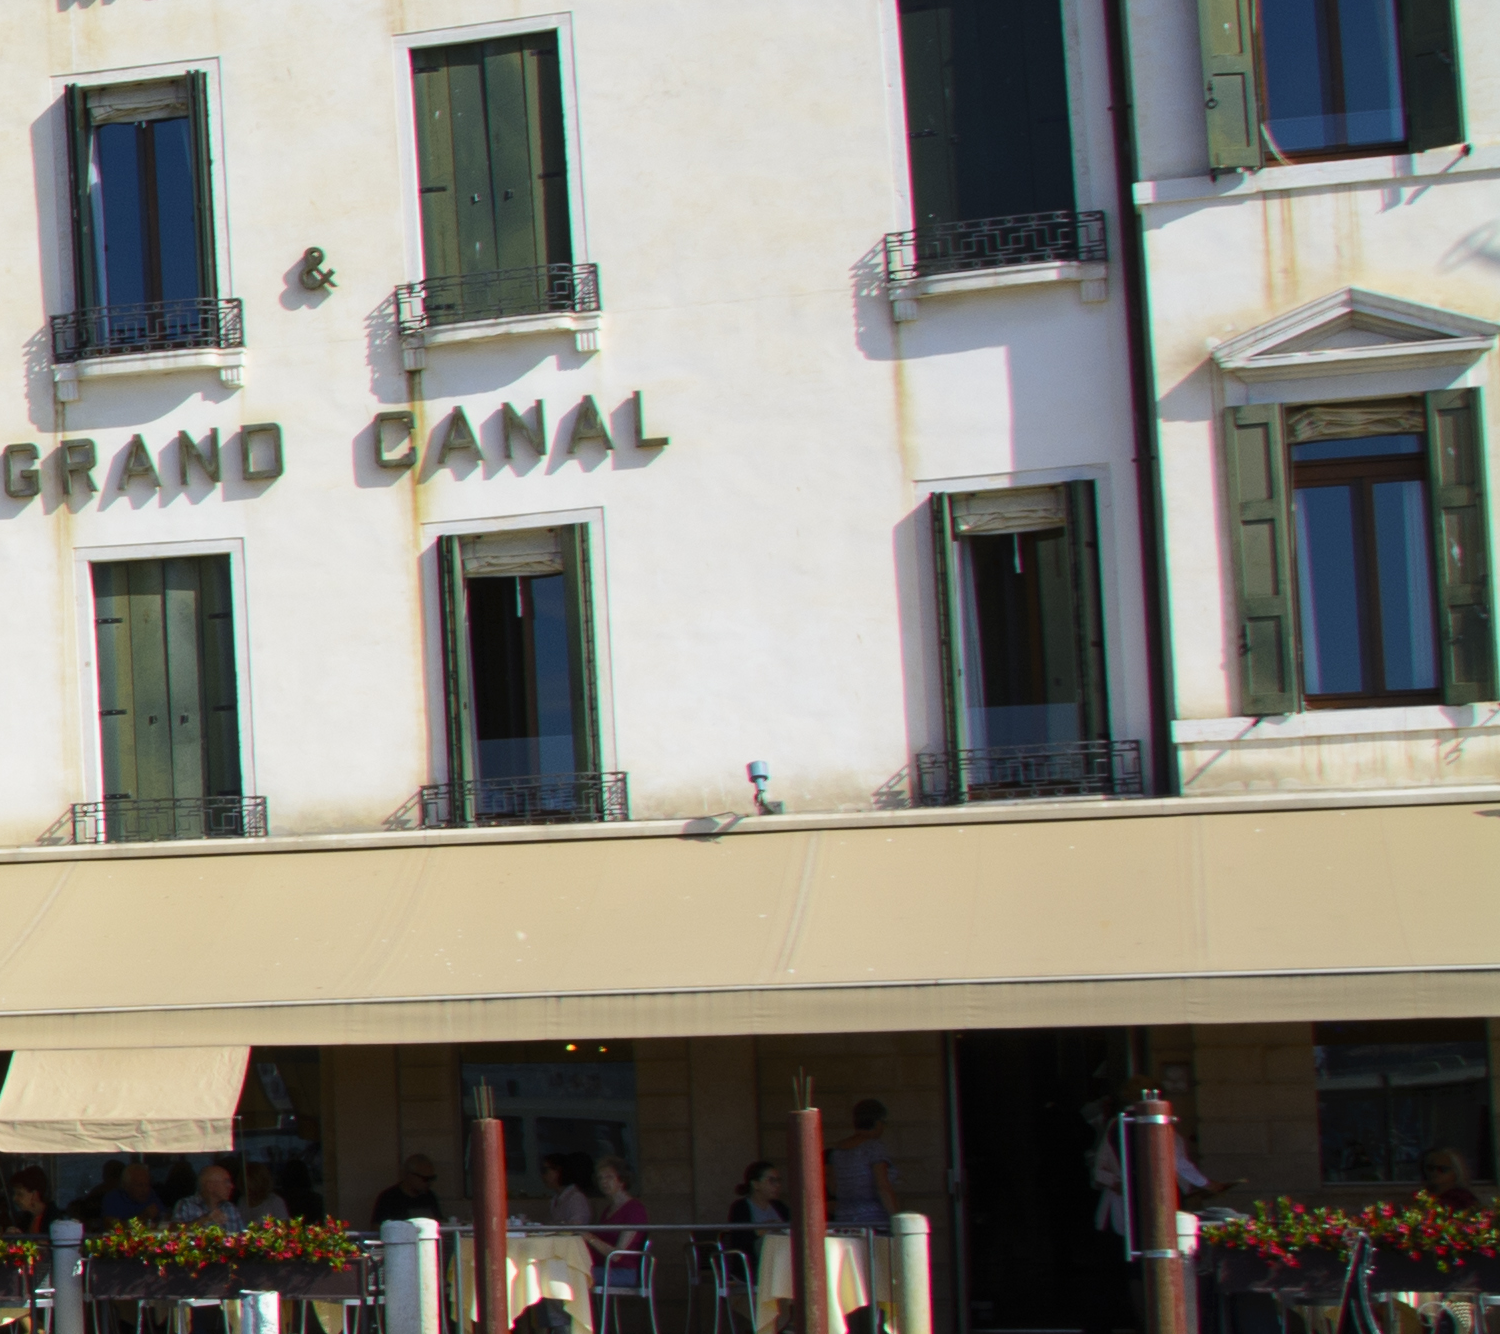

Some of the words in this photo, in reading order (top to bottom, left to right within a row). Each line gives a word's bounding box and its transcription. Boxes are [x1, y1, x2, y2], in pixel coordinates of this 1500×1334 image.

[300, 246, 338, 291] &
[3, 422, 285, 498] GRAND
[373, 390, 672, 468] CANAL
